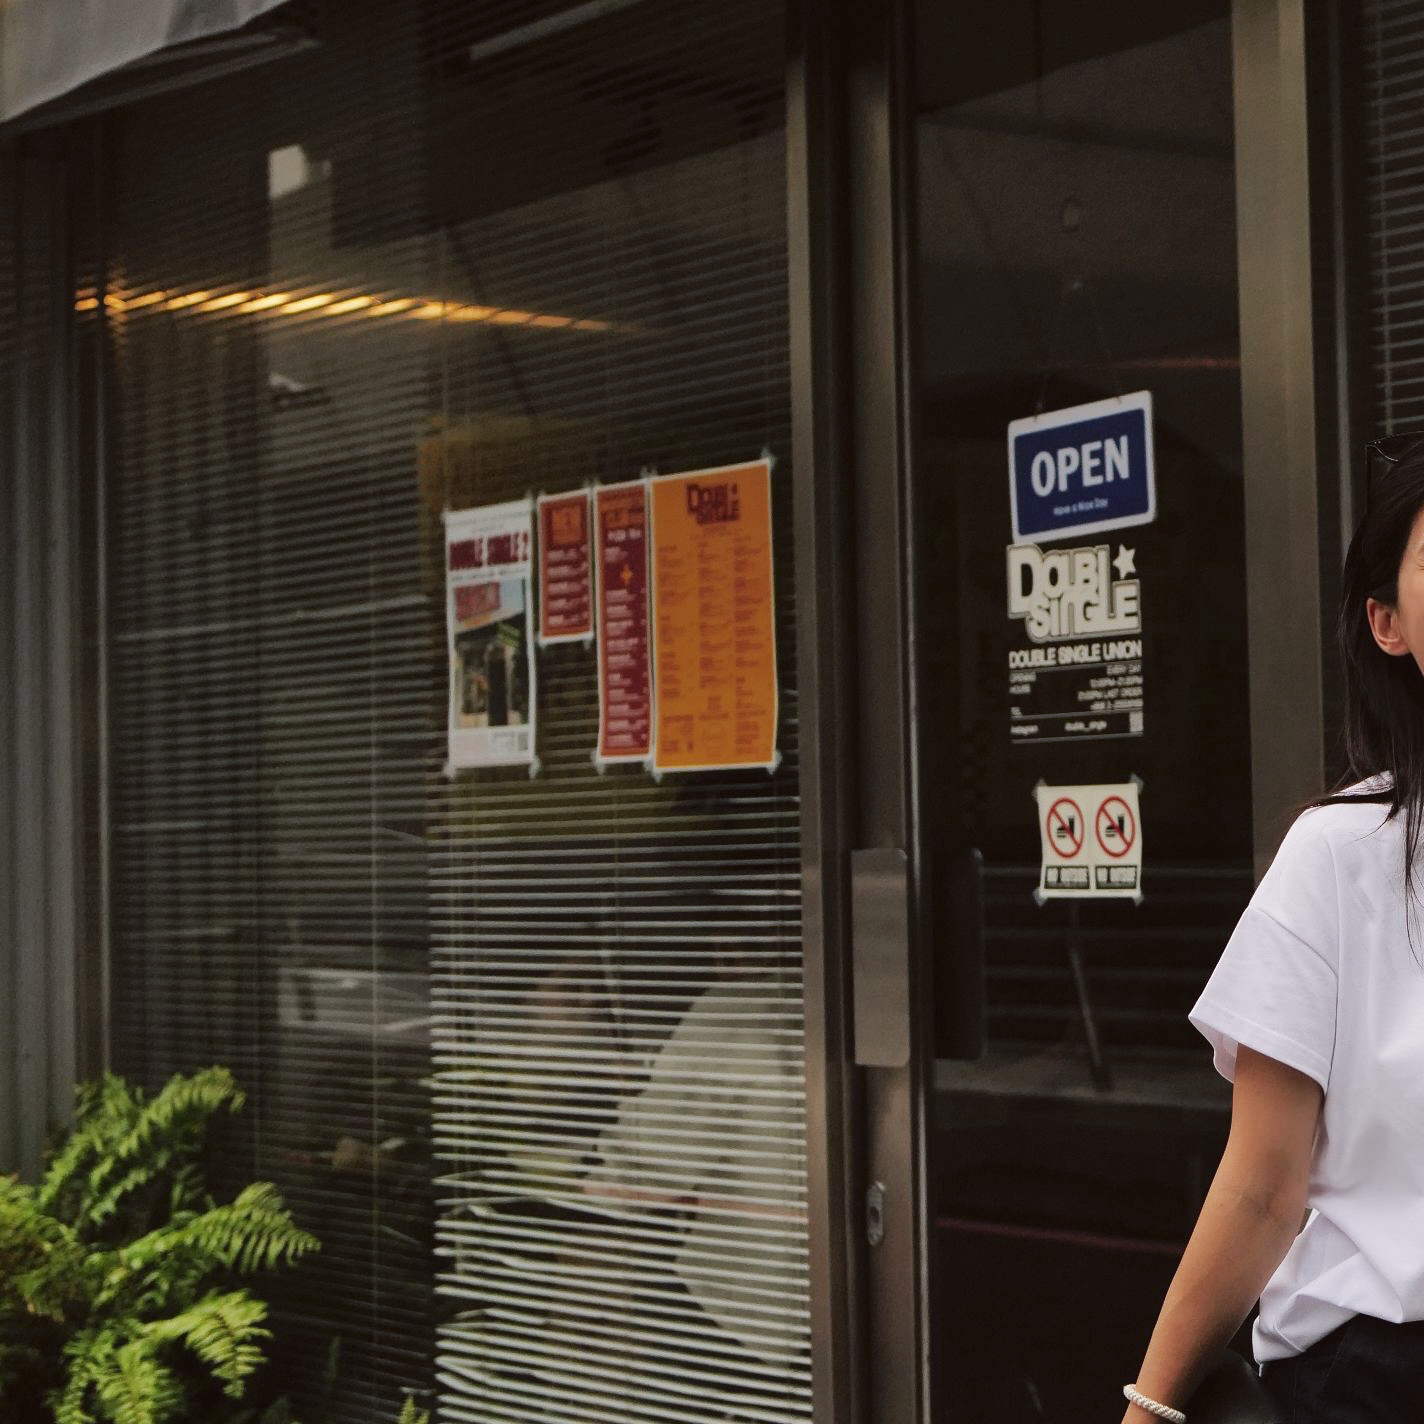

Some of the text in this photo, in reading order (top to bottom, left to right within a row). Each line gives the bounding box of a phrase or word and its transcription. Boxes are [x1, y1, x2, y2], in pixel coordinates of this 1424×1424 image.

[1031, 435, 1130, 497] OPEN
[1009, 639, 1143, 669] DOUBLE SINGLE UNION
